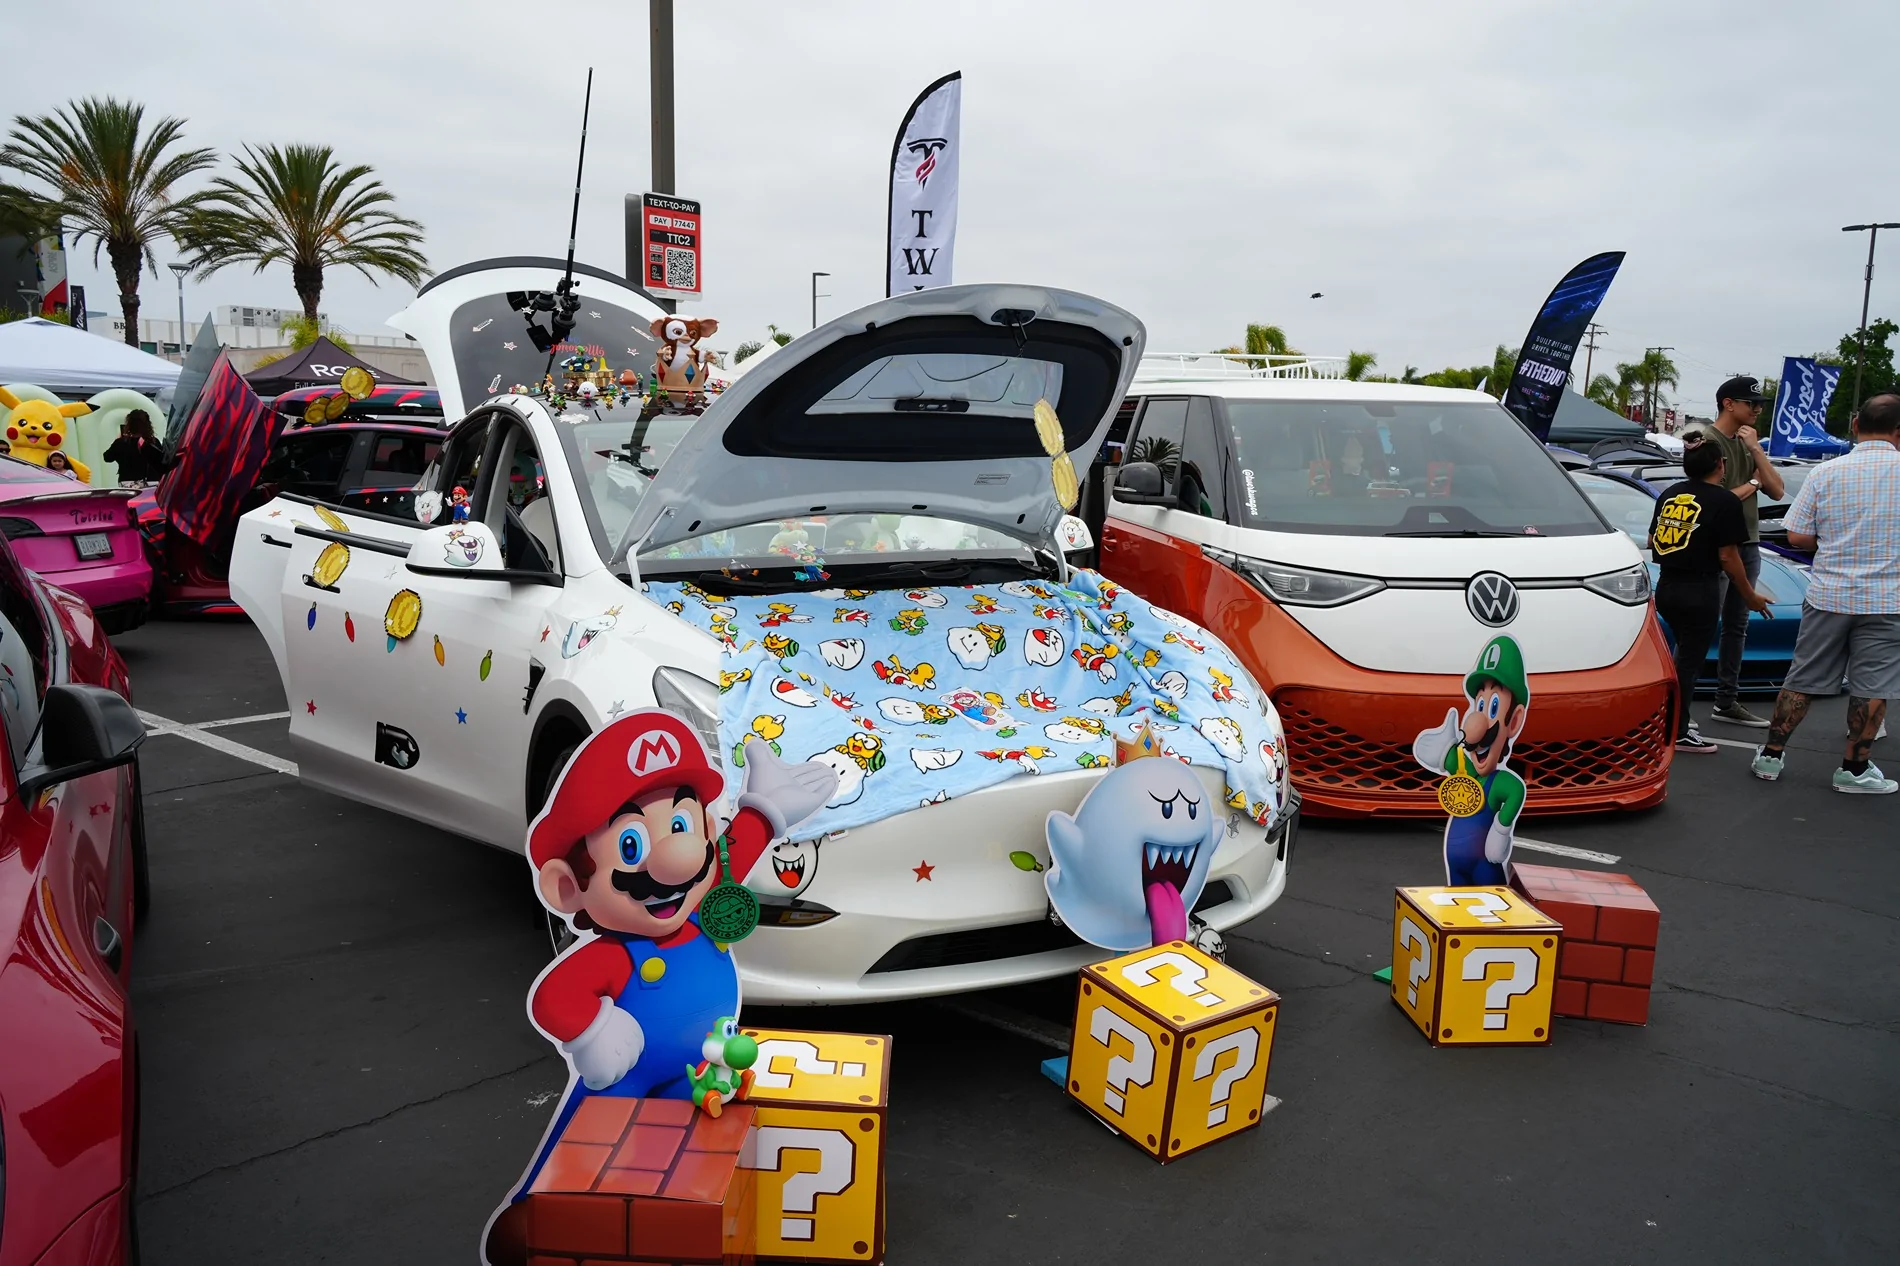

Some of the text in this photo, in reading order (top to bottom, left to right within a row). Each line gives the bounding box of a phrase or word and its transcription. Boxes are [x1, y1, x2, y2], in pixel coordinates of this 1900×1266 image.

[648, 198, 696, 213] TEXT-TO-PAY
[653, 216, 695, 229] PAY 77447
[667, 232, 691, 246] TTC2
[549, 342, 606, 358] Meorial
[1519, 359, 1567, 387] #THEDUO
[1662, 505, 1696, 521] DAY
[1657, 525, 1687, 545] BAY
[1486, 647, 1496, 669] L
[635, 733, 677, 772] M
